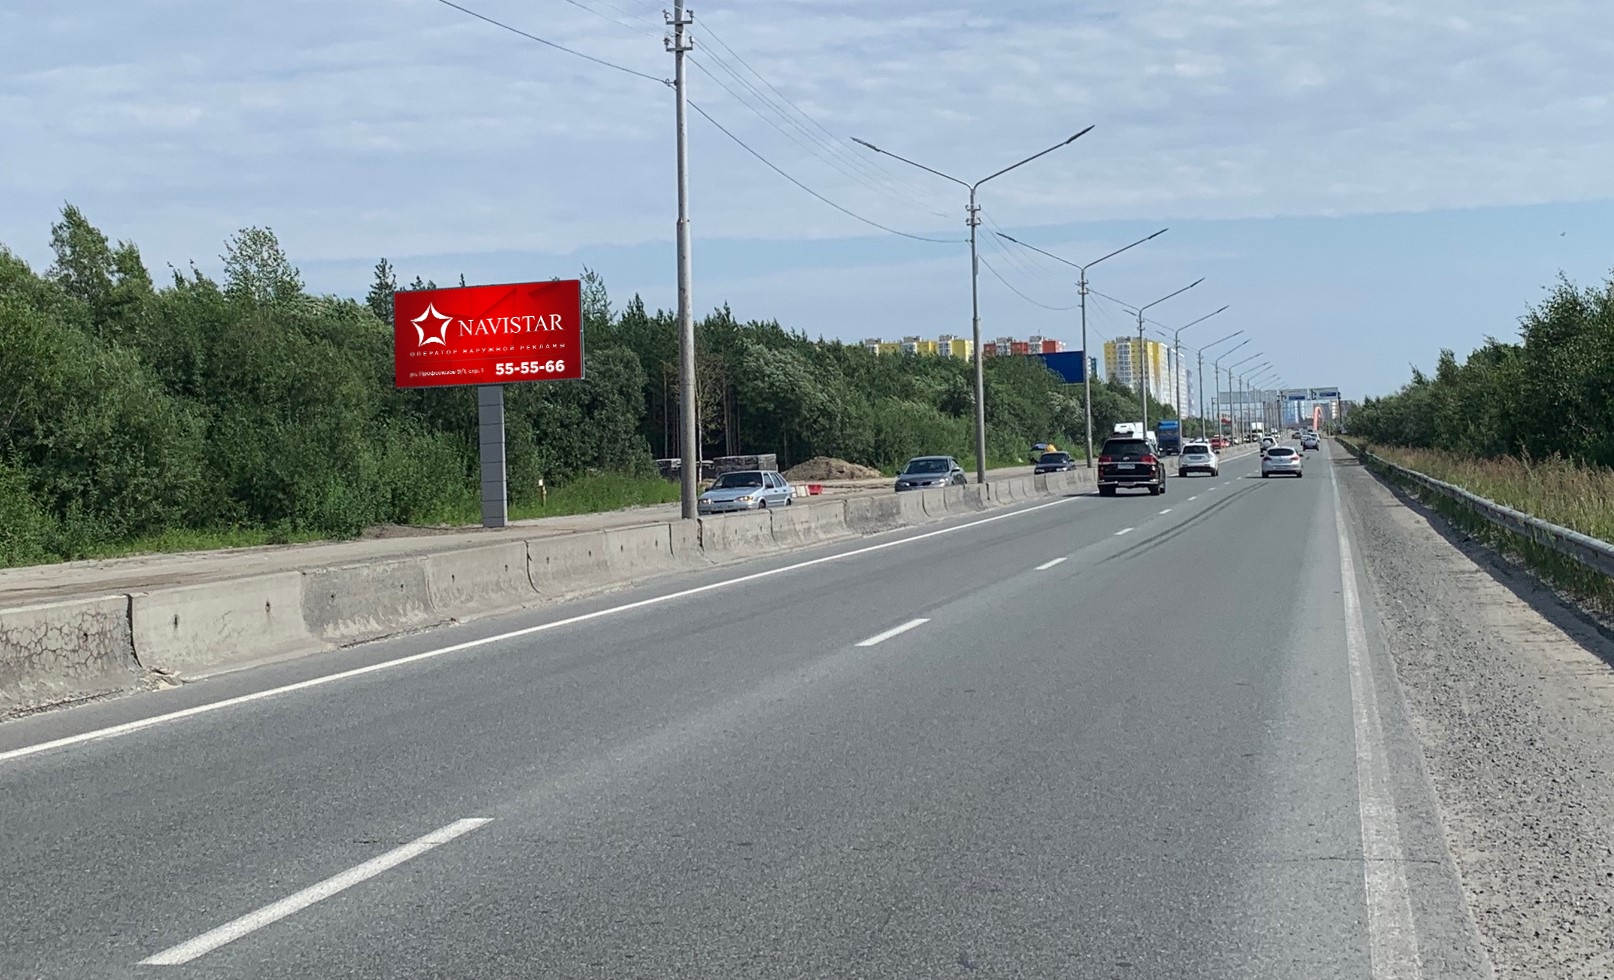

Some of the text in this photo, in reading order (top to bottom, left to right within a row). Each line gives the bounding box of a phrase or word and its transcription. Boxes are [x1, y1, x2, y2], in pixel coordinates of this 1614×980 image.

[458, 313, 564, 337] NAVISTAR
[409, 343, 566, 357] ОПЕРАТОР НАРУЖНОЙ РЕКЛАМЫ
[495, 360, 565, 376] 55-55-66
